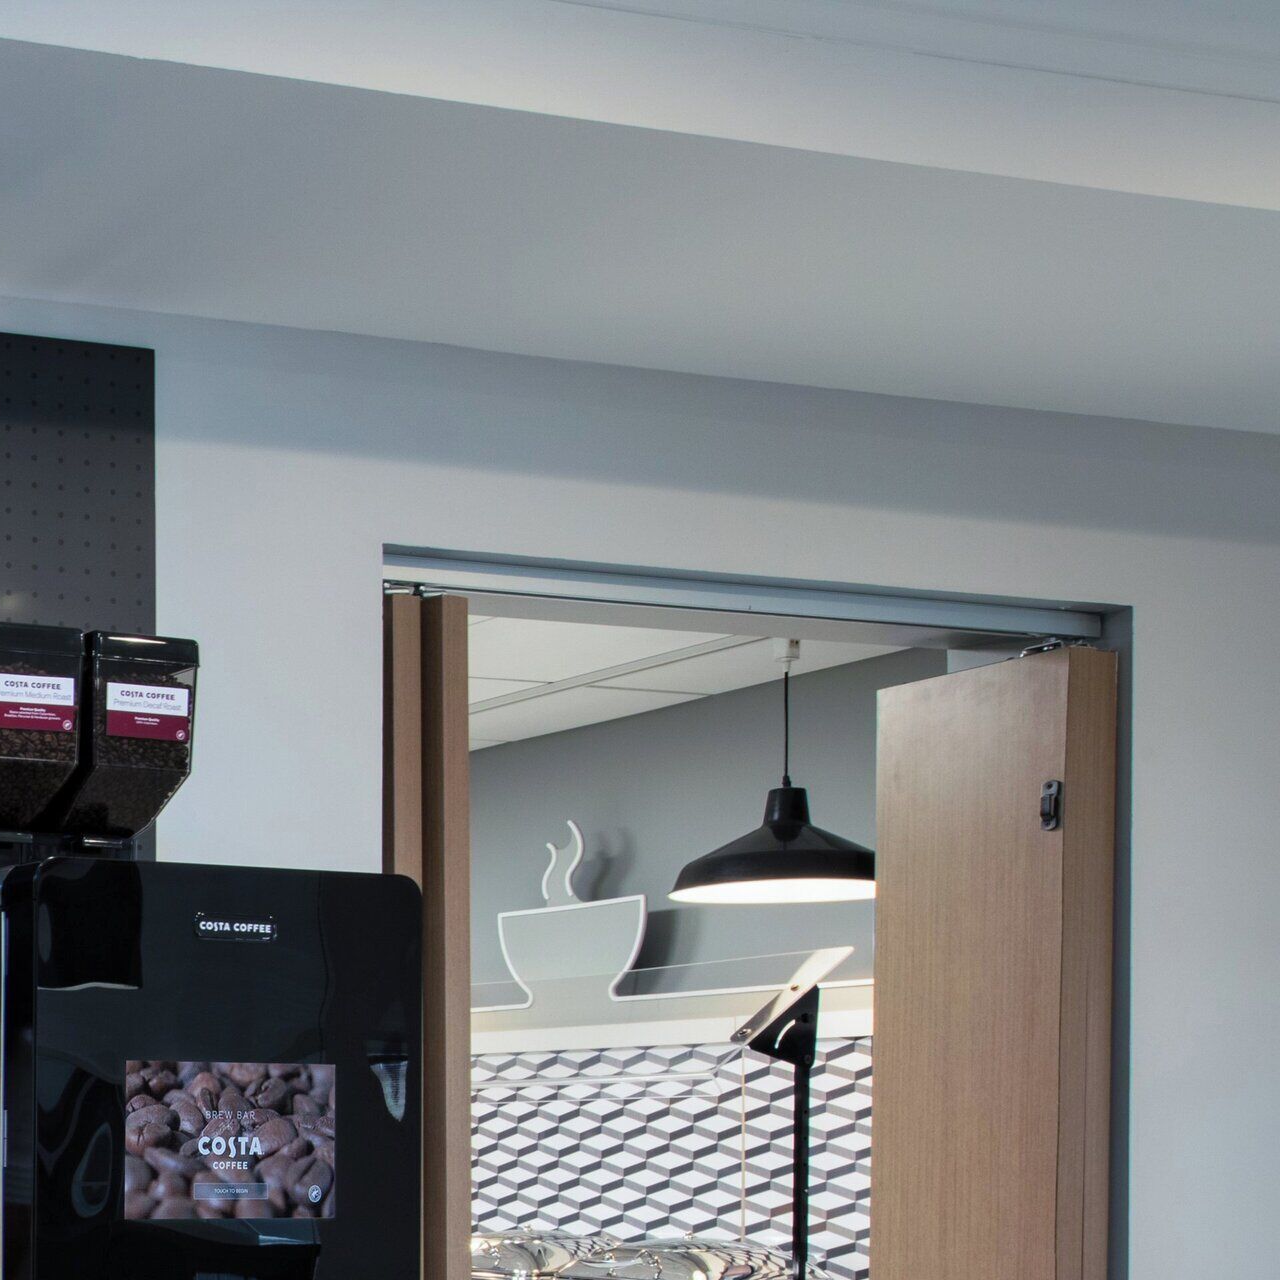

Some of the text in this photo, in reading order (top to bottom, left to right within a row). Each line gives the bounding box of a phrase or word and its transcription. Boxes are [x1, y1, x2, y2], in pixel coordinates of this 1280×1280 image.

[4, 680, 61, 690] COSTA COFFEE
[53, 692, 72, 701] Roast
[120, 690, 175, 701] COSTA COFFEE
[199, 921, 272, 933] COSTA COFFEE
[205, 1110, 256, 1120] BREW BAR
[198, 1136, 263, 1159] COSTA
[212, 1161, 248, 1170] COFFEE
